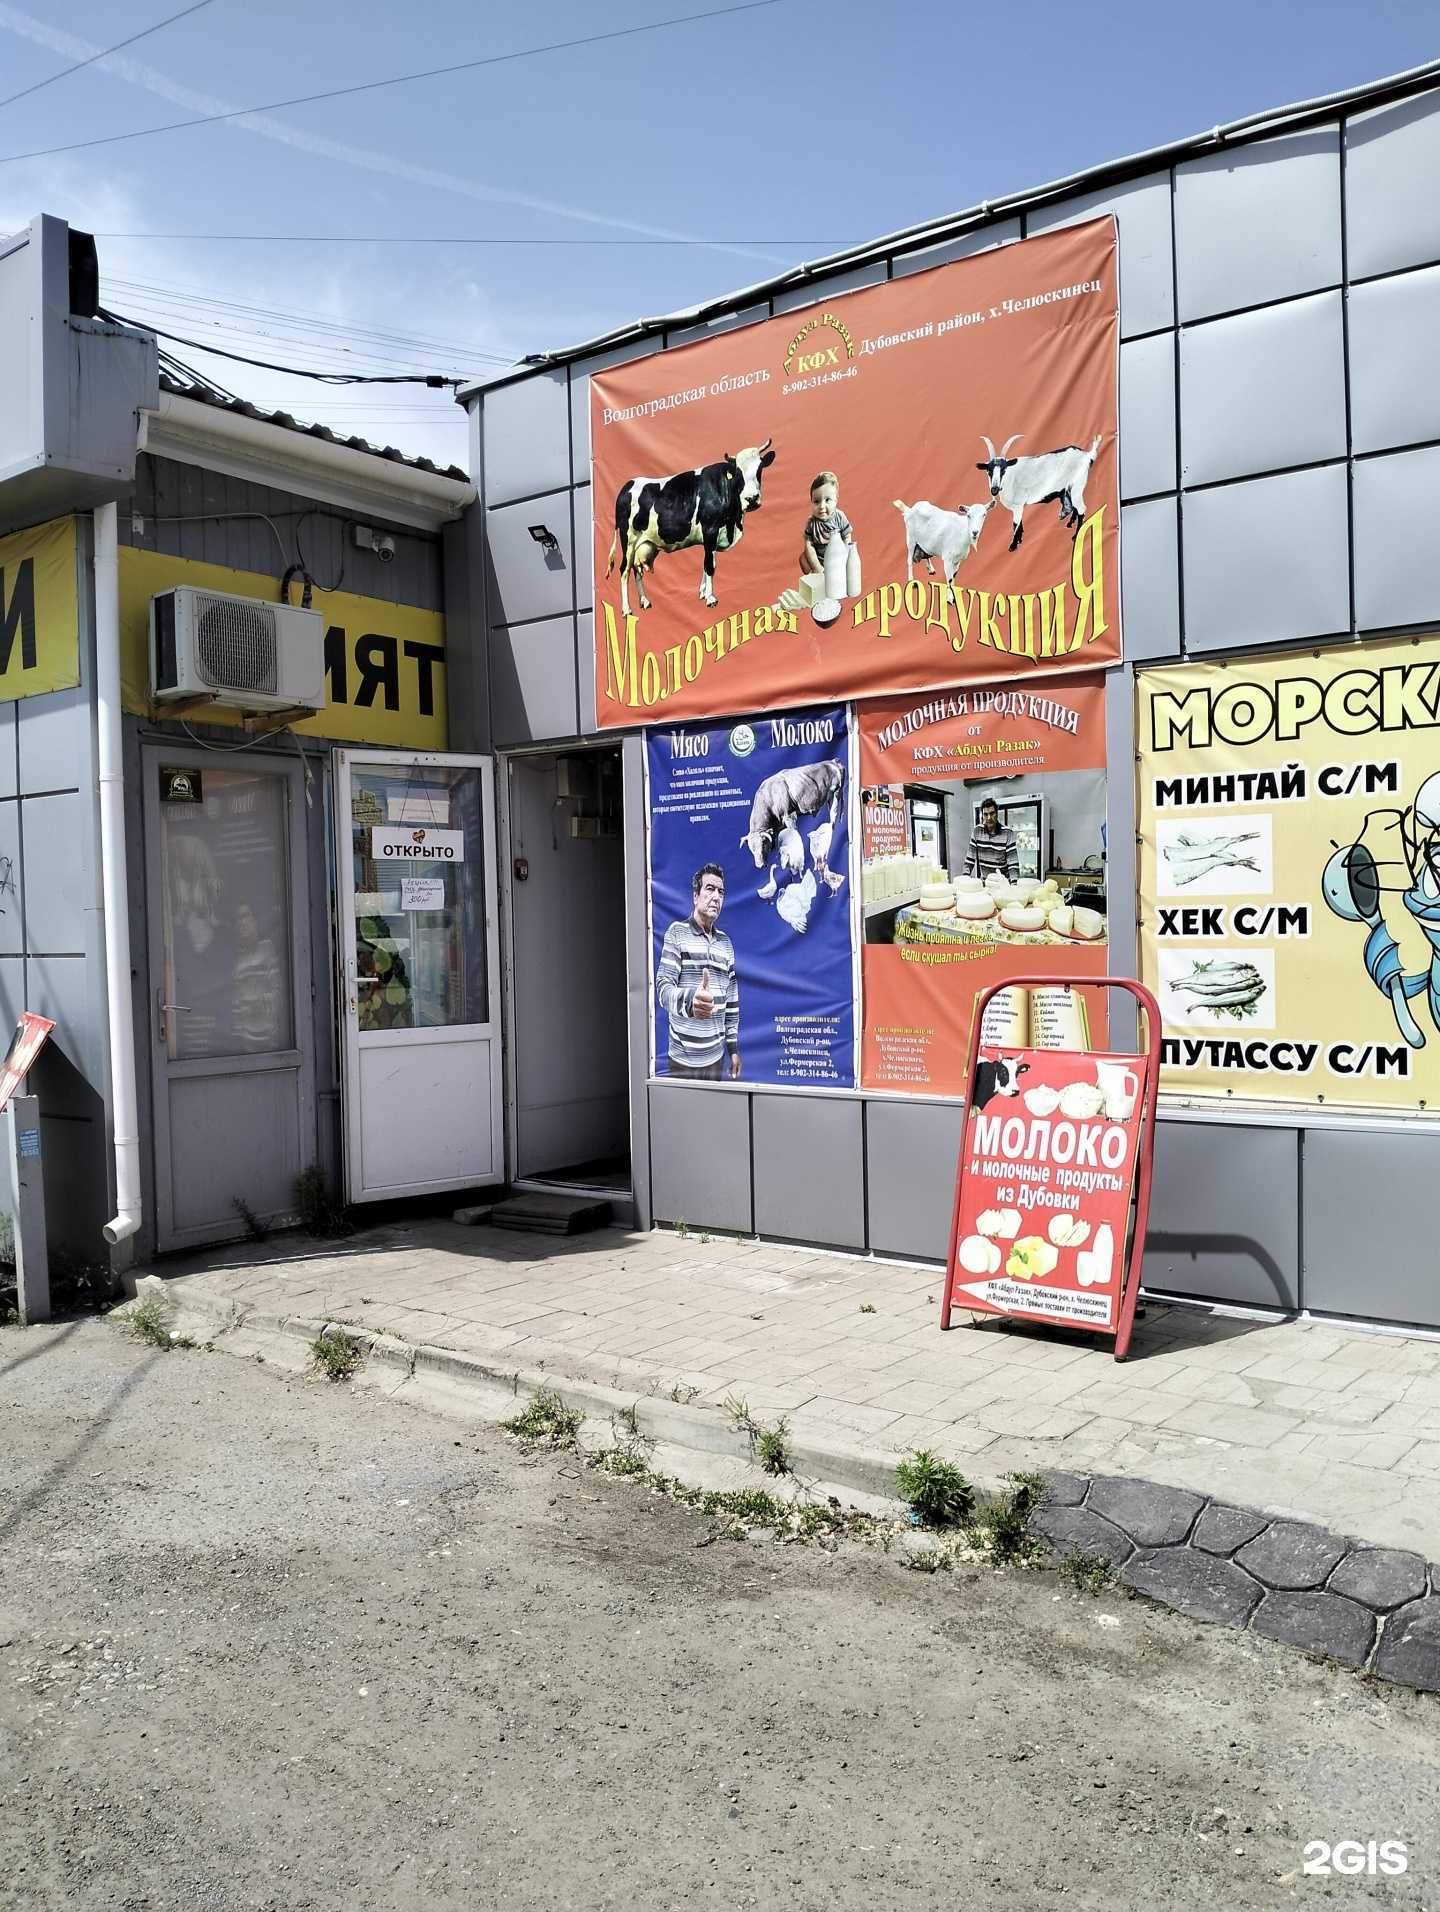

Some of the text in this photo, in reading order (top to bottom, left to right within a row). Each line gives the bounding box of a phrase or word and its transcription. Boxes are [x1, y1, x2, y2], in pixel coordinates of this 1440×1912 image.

[820, 313, 854, 359] Разак
[859, 321, 933, 356] Дубовский
[937, 310, 985, 336] район,
[797, 346, 840, 374] КФХ
[782, 365, 858, 395] 8-902-314-86-46
[602, 369, 770, 425] Волгоградская область
[602, 600, 799, 708] Молочная
[877, 691, 1080, 753] МОЛОЧНАЯ ПРОДУКЦИЯ
[1150, 662, 1440, 752] МОРСК
[670, 719, 834, 760] Мясо Молоко
[967, 725, 982, 736] от
[911, 755, 1045, 776] продукция от производителя
[913, 739, 1041, 760] КФХ «Абдул Разак»
[1155, 762, 1398, 807] МИНТАЙ С/М
[865, 806, 904, 826] МОЛОКО
[383, 845, 454, 858] ОТКРЫТО
[897, 921, 925, 941] Жизнь
[925, 933, 961, 946] приятна
[1158, 906, 1309, 937] ХЕК С/М
[901, 944, 998, 966] если скушал ты сырка!
[1160, 1038, 1409, 1076] ПУТАССУ С/М
[973, 1115, 1129, 1169] МОЛОКО
[970, 1161, 1123, 1194] и молочные продукты
[996, 1185, 1080, 1210] из Дубовки
